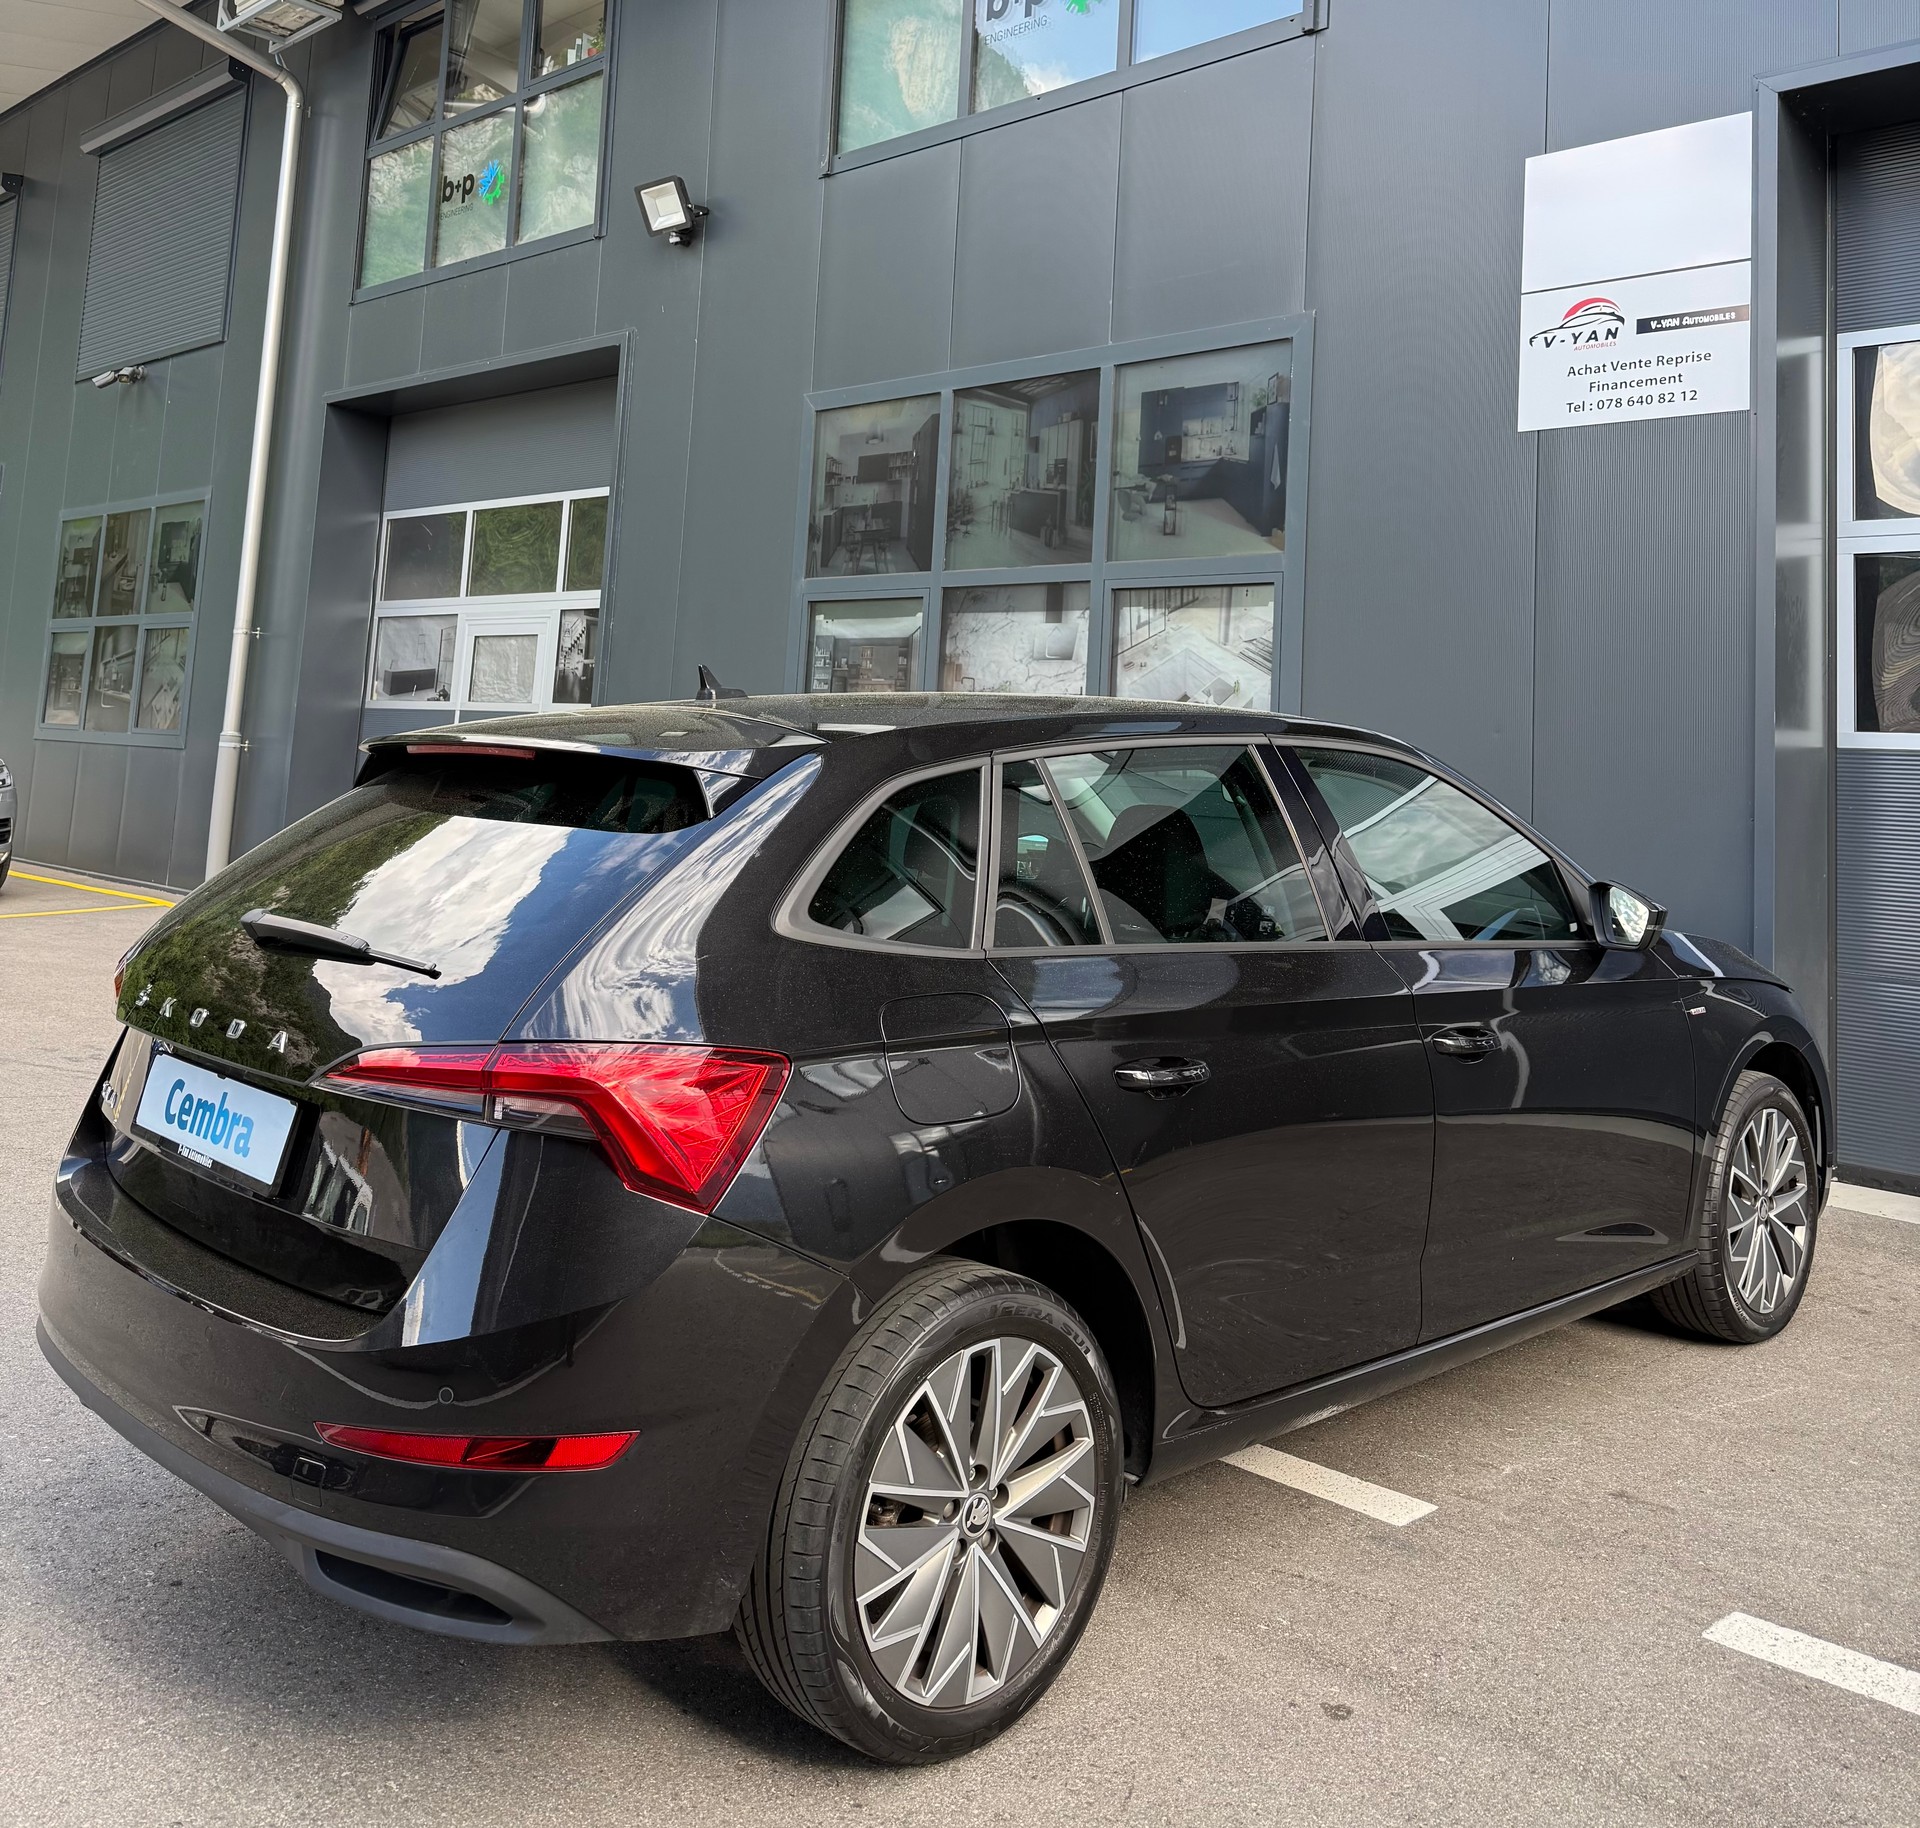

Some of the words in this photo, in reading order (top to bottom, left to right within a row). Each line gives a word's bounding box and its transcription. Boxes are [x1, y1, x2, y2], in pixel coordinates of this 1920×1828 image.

[984, 15, 1048, 45] ENGINEERING
[441, 174, 475, 204] b+p
[1650, 317, 1680, 329] V-YAN
[1543, 327, 1619, 348] V-YAN
[1573, 341, 1617, 351] AUTOMOBILES
[1567, 363, 1607, 377] Achat
[1611, 360, 1652, 372] Vente
[1656, 351, 1712, 368] Reprise
[1589, 373, 1684, 392] Financement
[1566, 400, 1585, 413] Tel
[1597, 398, 1623, 410] 078
[1627, 394, 1654, 407] 640
[1658, 392, 1675, 404] 82
[1681, 390, 1698, 401] 12
[164, 1078, 255, 1158] Cembra
